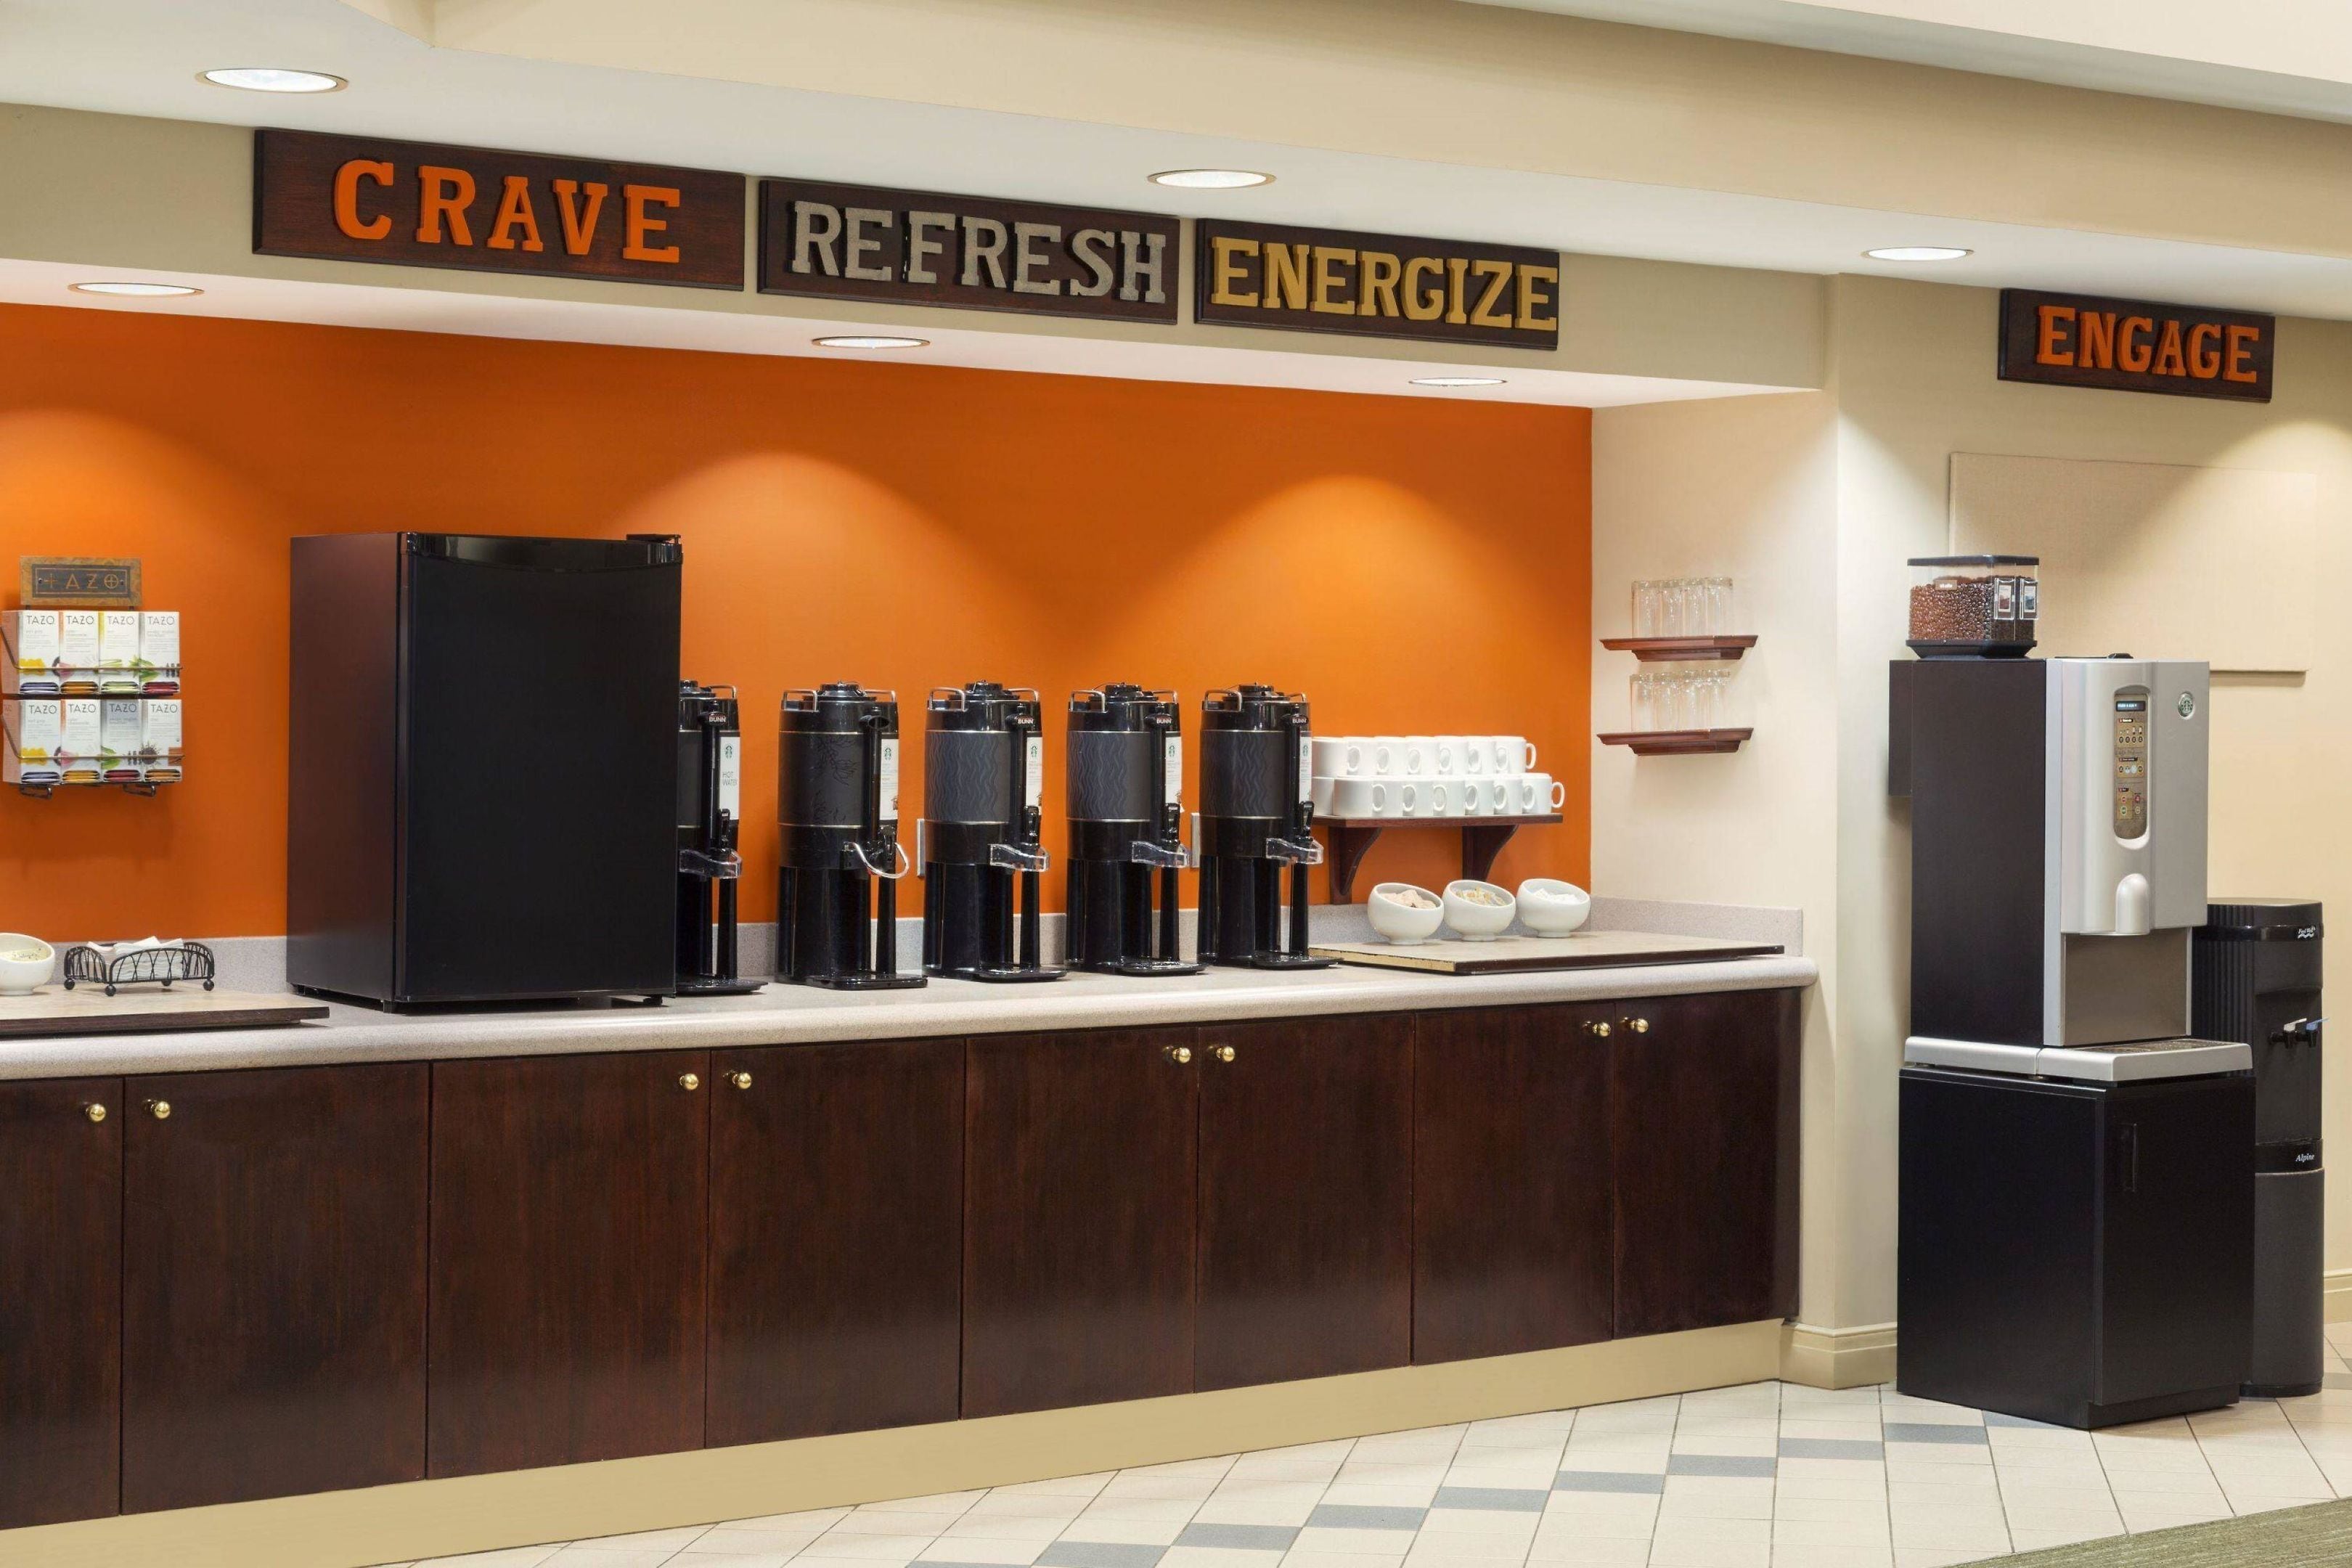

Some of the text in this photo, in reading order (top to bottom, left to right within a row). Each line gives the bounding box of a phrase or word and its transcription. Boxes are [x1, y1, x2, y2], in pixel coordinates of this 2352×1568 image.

[333, 159, 680, 263] CRAVE
[791, 200, 1167, 304] REFRESH
[1210, 236, 1559, 331] ENERGIZE
[2036, 305, 2260, 383] ENGAGE
[26, 615, 55, 625] TAZO
[65, 615, 94, 625] TAZO
[107, 616, 135, 625] TAZO
[147, 616, 175, 626] TAZO
[28, 705, 57, 714] TAZO
[68, 703, 97, 714] TAZO
[109, 703, 137, 713] TAZO
[150, 703, 178, 713] TAZO
[2295, 1153, 2315, 1163] Alpine
